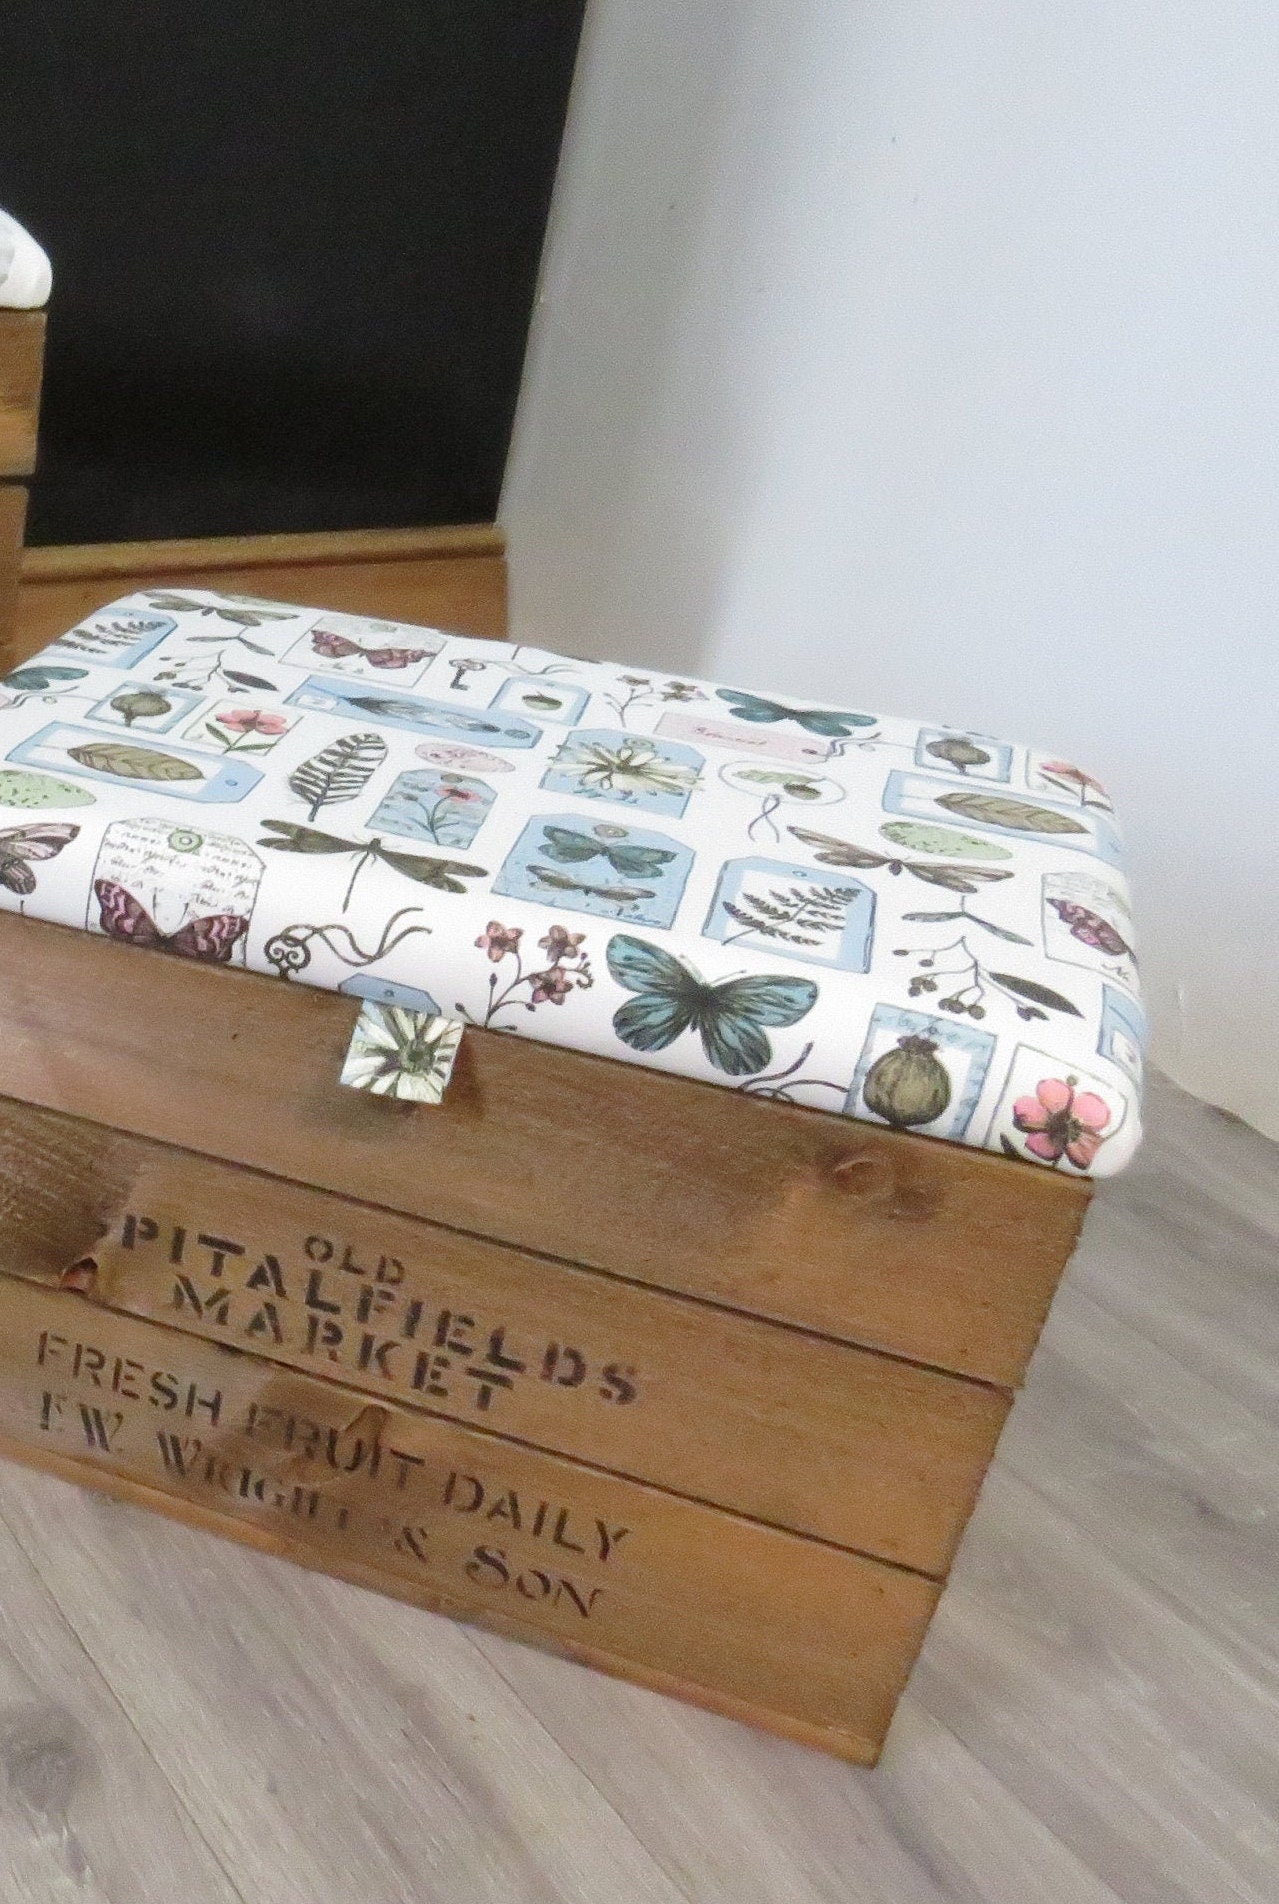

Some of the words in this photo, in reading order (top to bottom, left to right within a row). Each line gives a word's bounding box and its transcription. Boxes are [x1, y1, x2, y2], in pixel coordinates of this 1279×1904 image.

[96, 1210, 640, 1406] PITALFIELDS
[304, 1234, 407, 1284] OLD
[174, 1275, 516, 1412] MARKET
[36, 1329, 225, 1426] FRESH
[245, 1401, 426, 1491] FRUIT
[442, 1471, 632, 1562] DAILY
